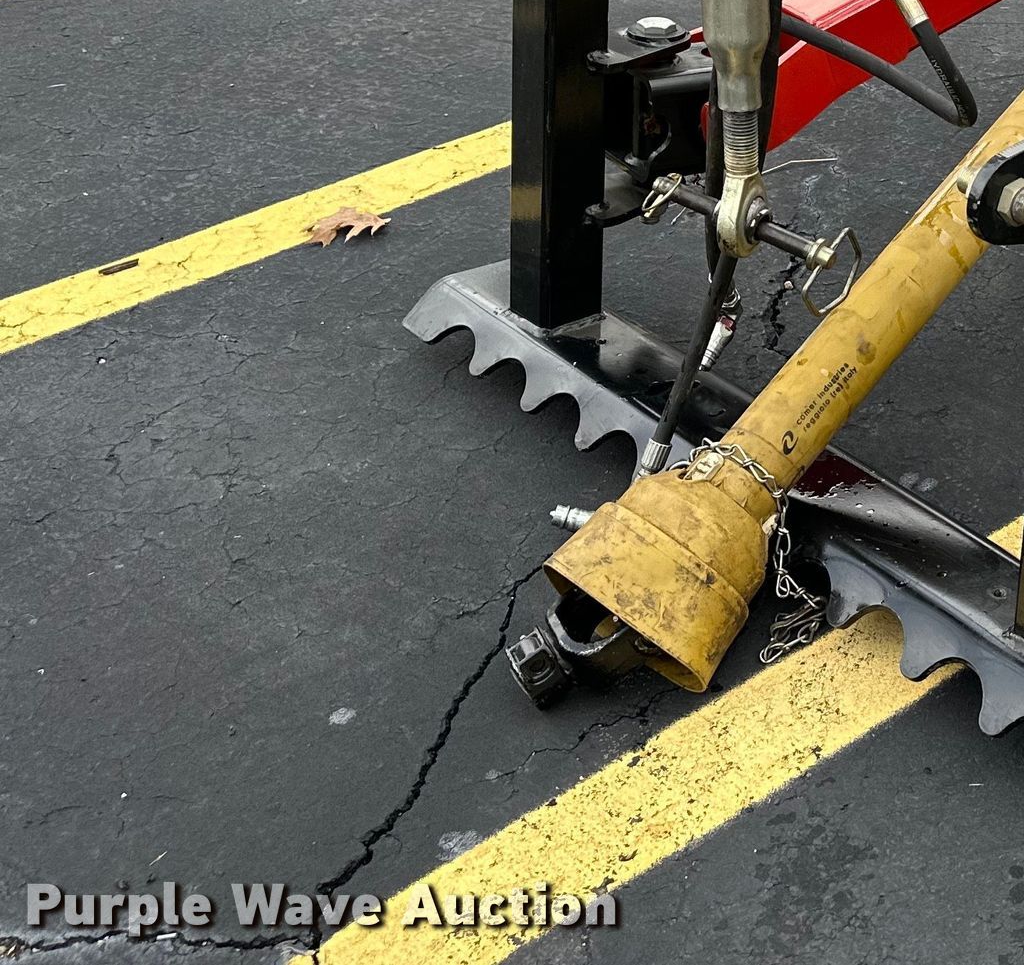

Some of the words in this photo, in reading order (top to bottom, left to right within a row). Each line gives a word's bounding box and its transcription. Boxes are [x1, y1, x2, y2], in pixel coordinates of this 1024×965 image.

[796, 400, 817, 425] comer
[817, 362, 850, 400] industries
[803, 399, 831, 433] reggiolo
[831, 382, 844, 398] (re)
